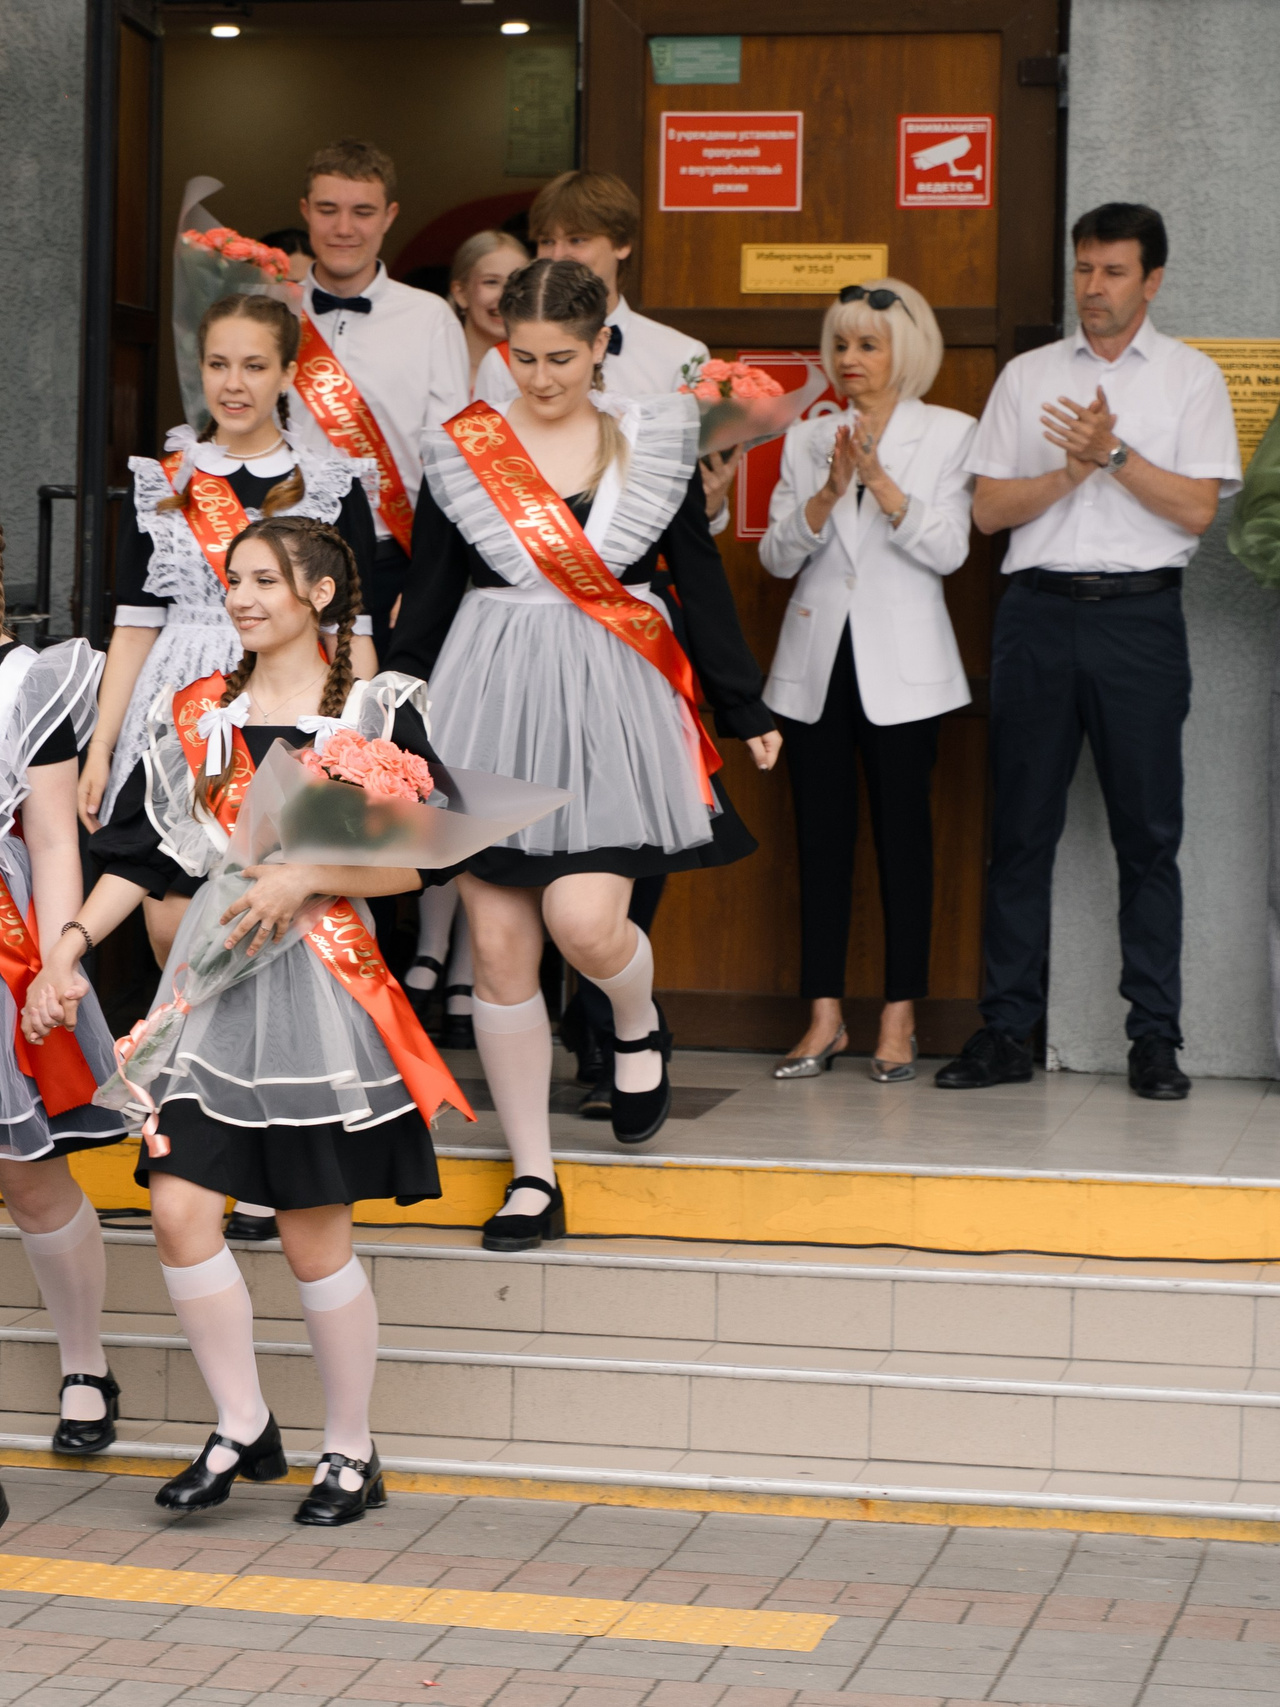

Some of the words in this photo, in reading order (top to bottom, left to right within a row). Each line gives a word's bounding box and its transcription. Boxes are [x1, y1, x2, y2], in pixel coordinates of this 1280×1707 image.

[712, 183, 749, 194] режим
[916, 181, 974, 193] ВЕДЕТСЯ
[756, 252, 833, 262] Избирательный
[835, 254, 872, 263] участок
[491, 455, 602, 596] Выпускница
[322, 906, 386, 979] 2026
